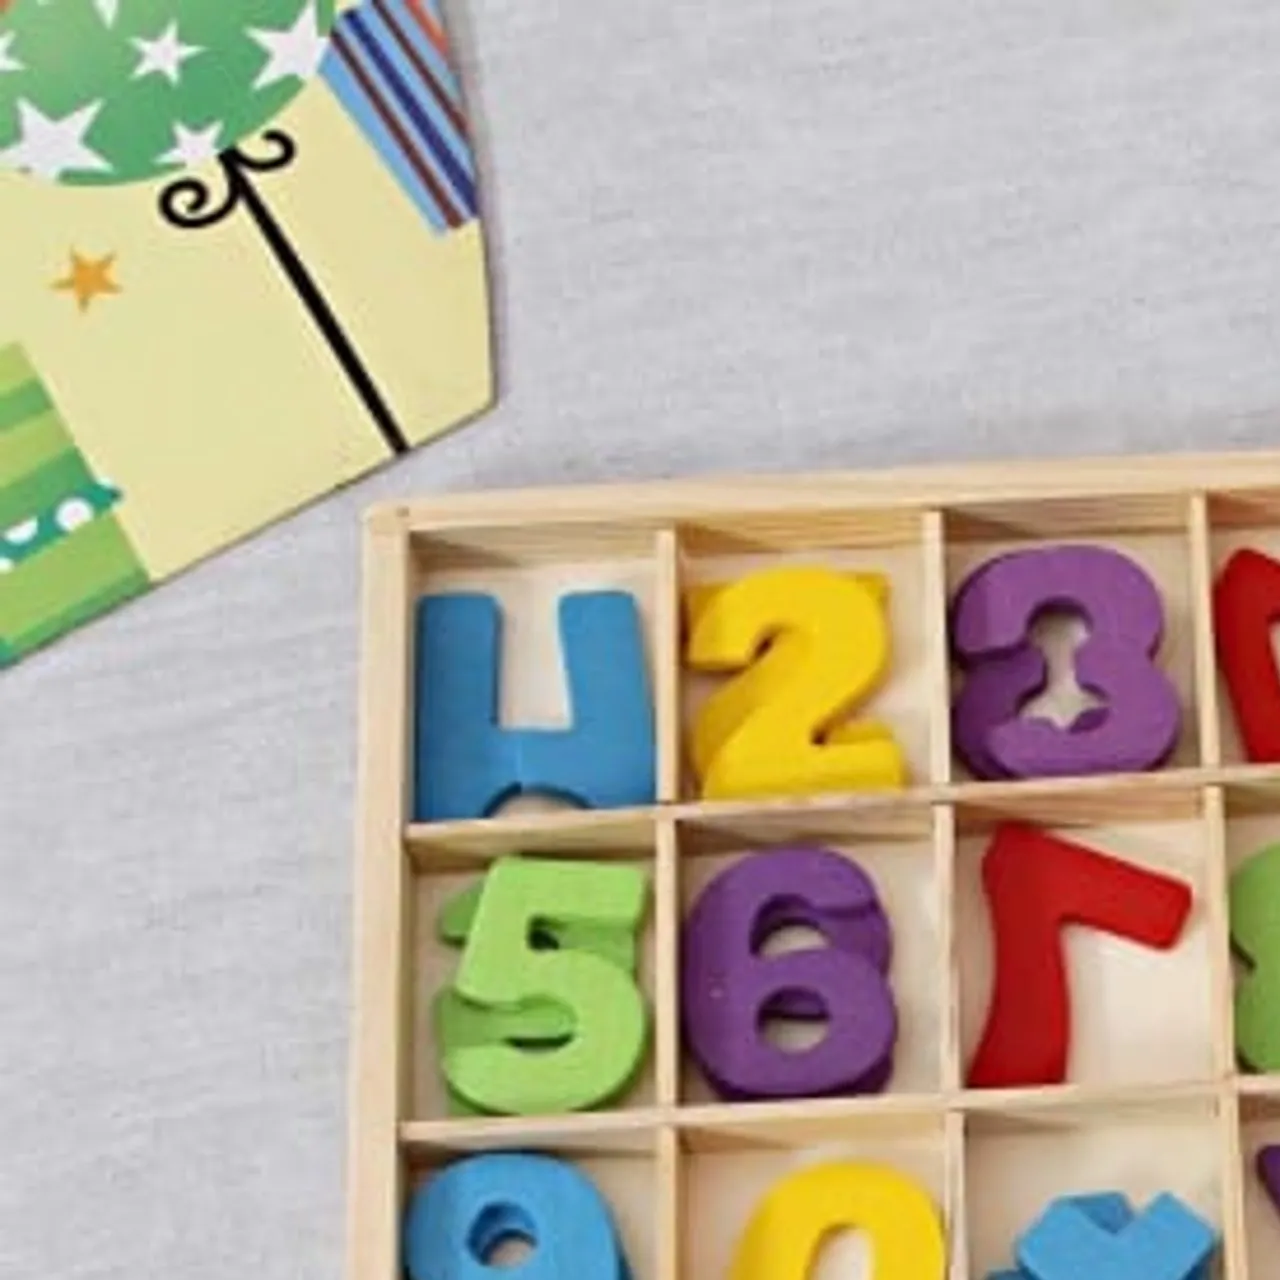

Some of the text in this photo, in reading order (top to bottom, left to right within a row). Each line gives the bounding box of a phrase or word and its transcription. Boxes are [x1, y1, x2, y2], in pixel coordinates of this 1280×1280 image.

[688, 566, 908, 803] 2
[440, 855, 648, 1116] 5
[683, 845, 898, 1098] 6
